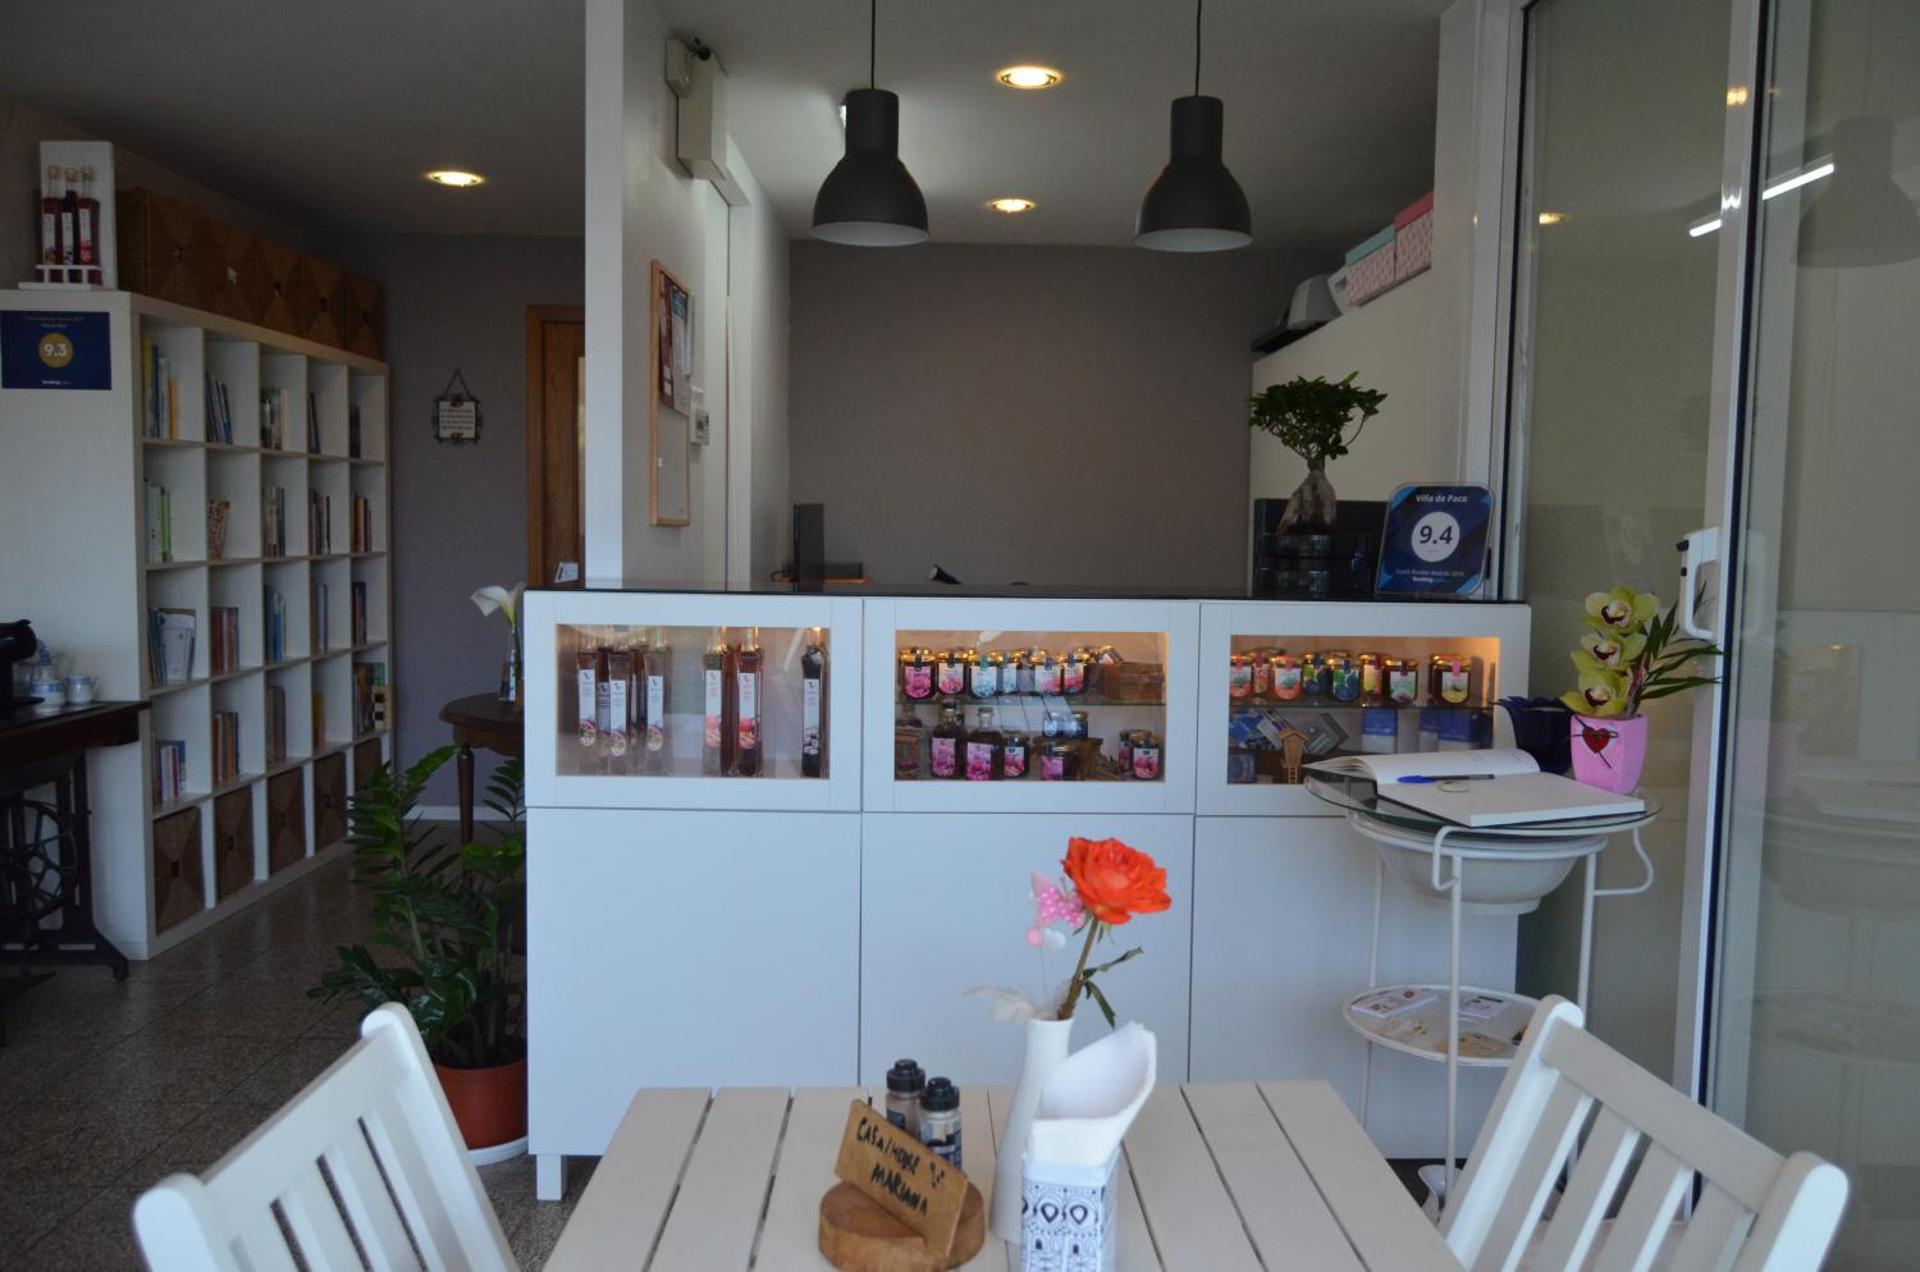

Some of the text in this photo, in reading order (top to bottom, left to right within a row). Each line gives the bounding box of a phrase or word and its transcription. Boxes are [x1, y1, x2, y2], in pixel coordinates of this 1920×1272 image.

[43, 343, 68, 357] 9.3
[1435, 494, 1446, 503] de
[1419, 525, 1453, 545] 9.4
